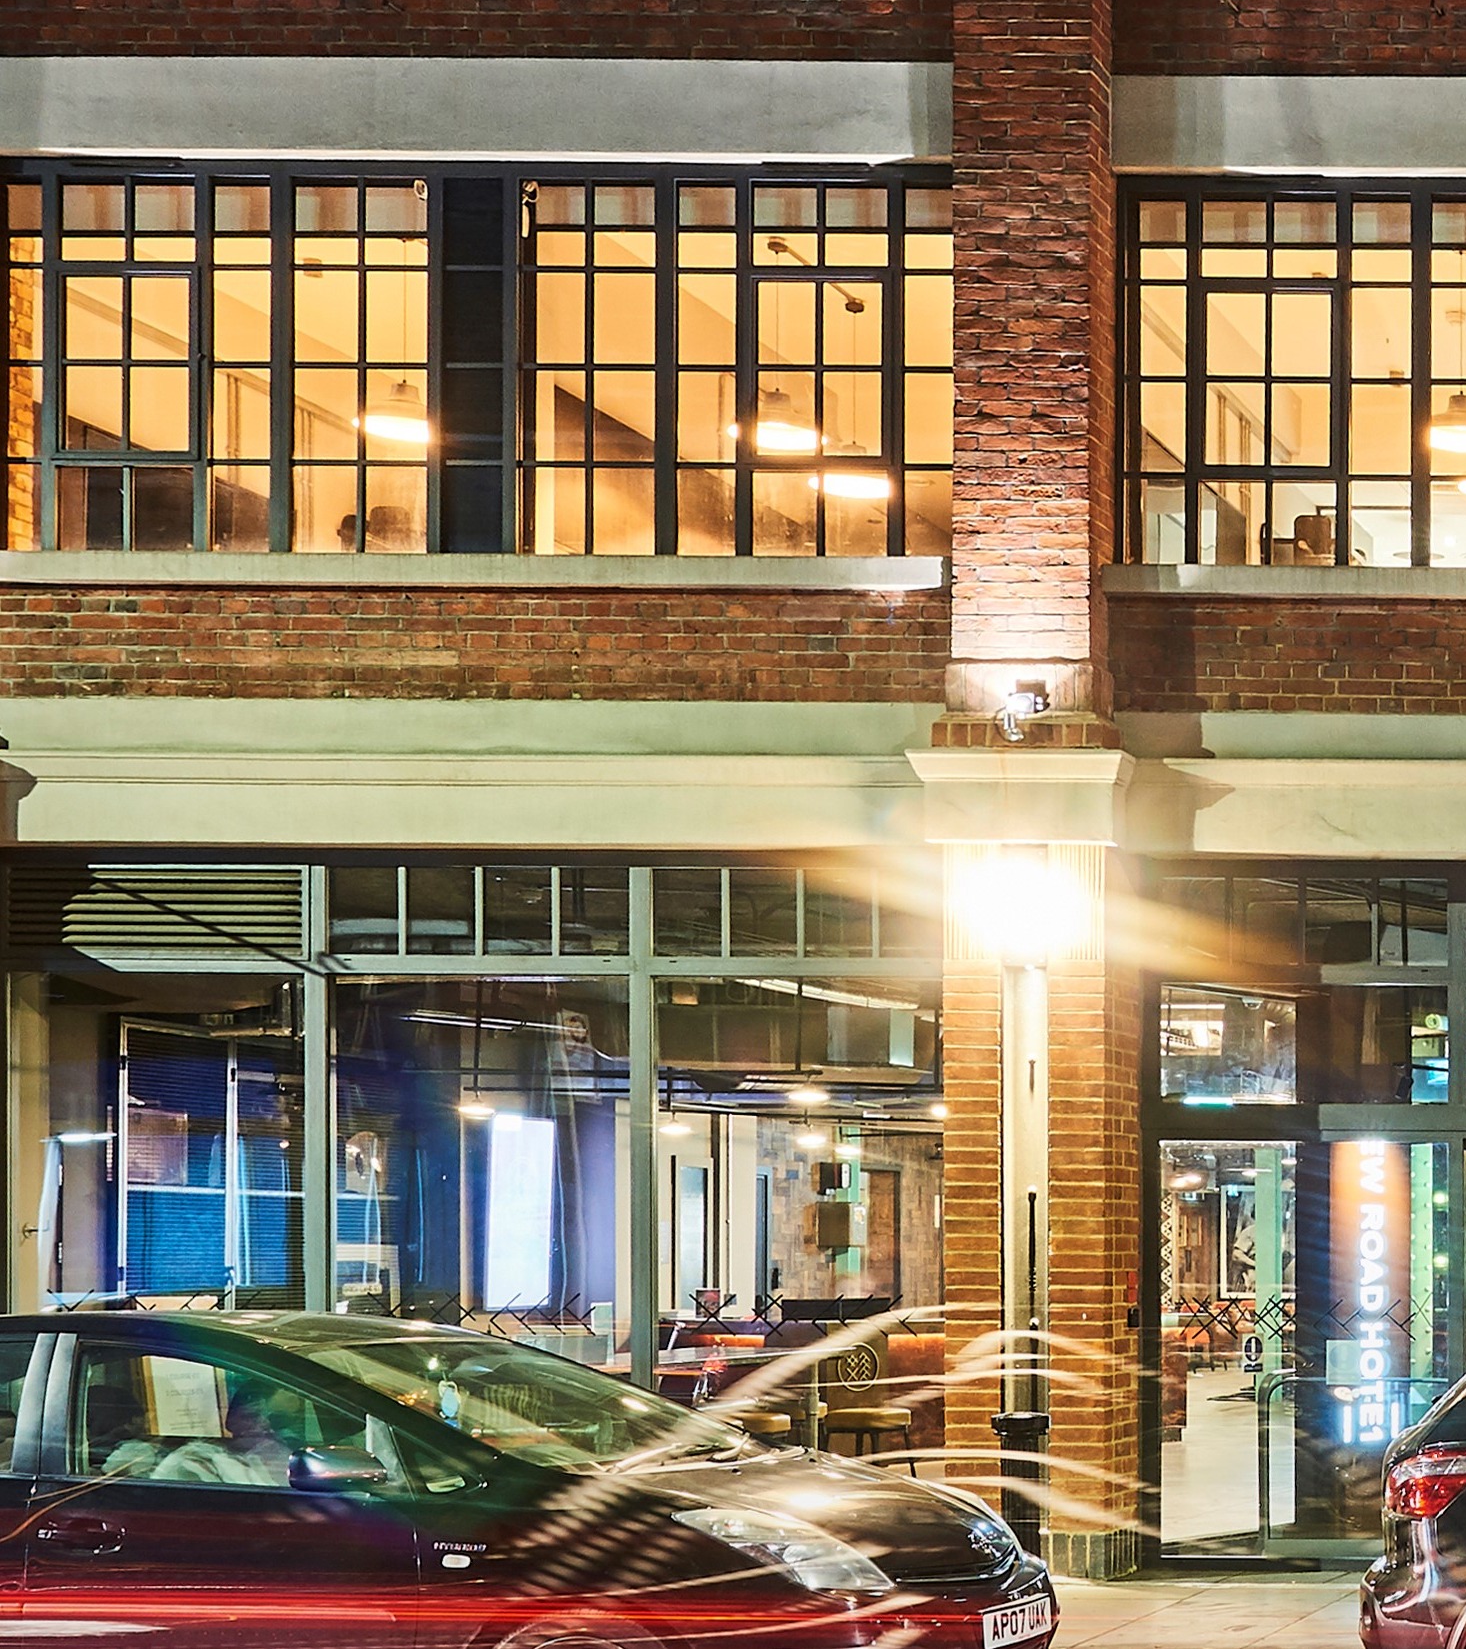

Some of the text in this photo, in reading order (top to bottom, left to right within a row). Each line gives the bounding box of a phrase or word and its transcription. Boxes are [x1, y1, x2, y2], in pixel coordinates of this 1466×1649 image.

[1360, 1141, 1385, 1194] EW
[1360, 1204, 1385, 1311] ROAD
[992, 1601, 1048, 1641] AP07 UAK
